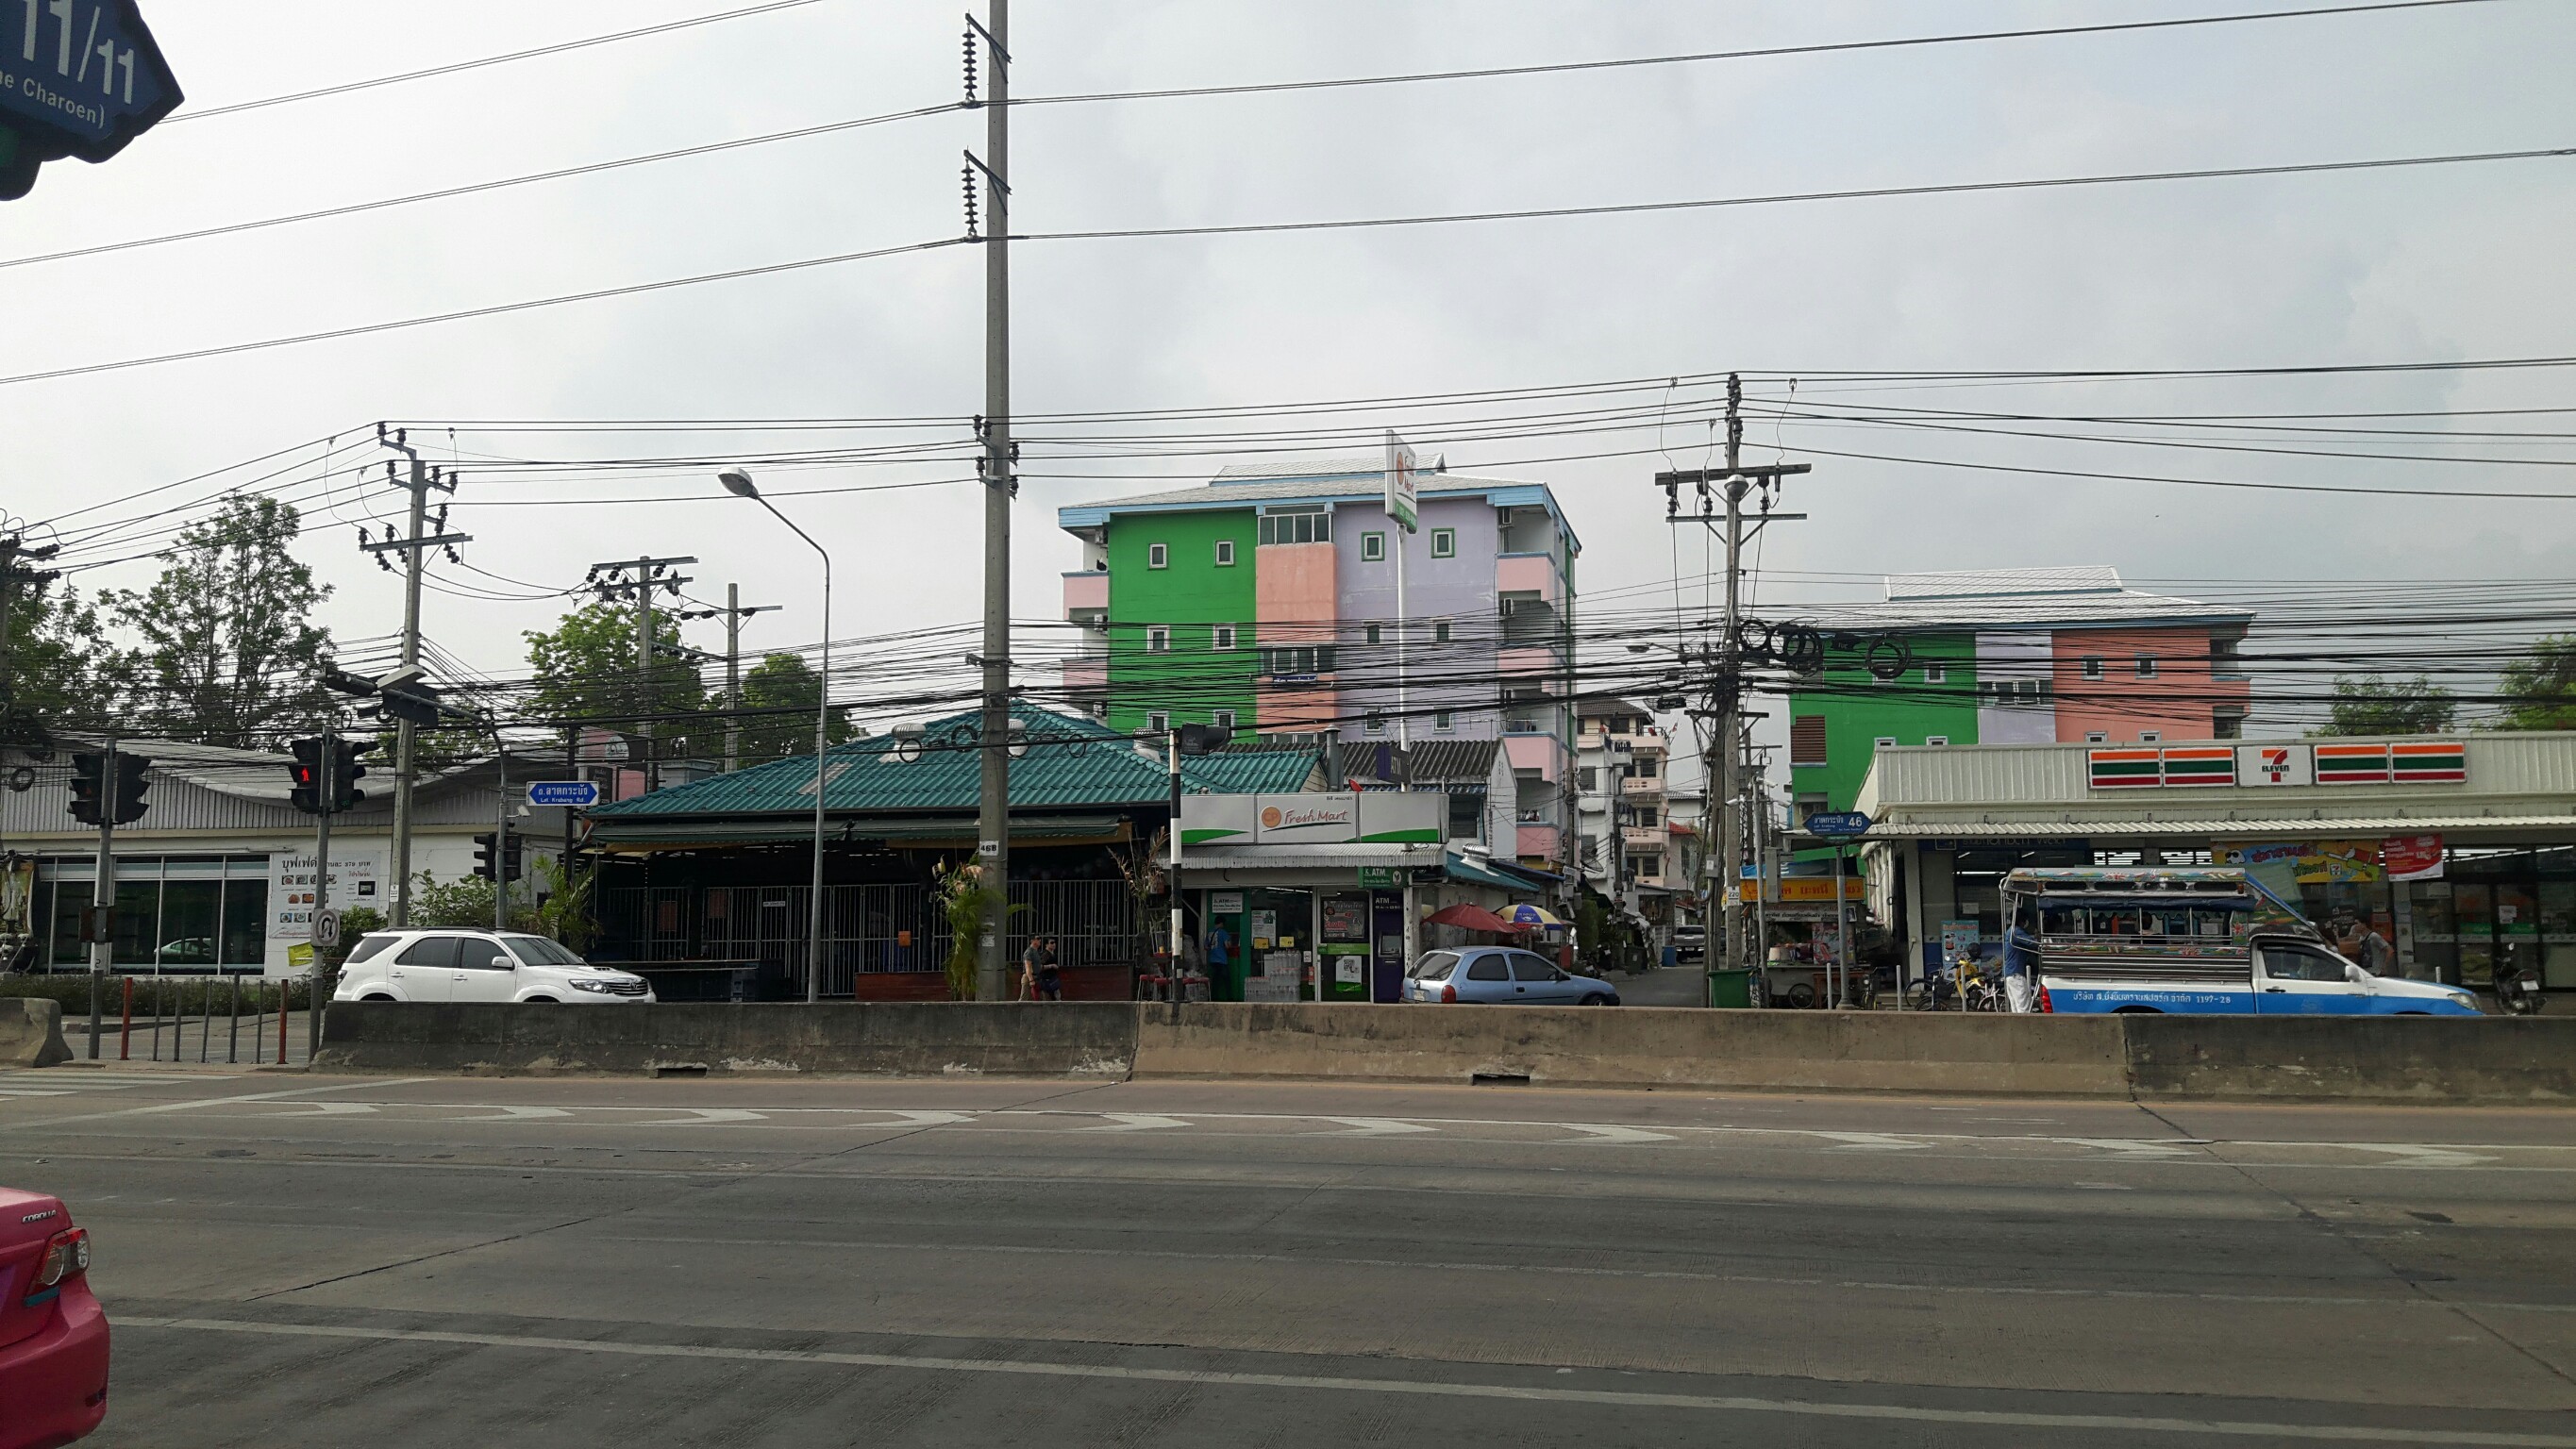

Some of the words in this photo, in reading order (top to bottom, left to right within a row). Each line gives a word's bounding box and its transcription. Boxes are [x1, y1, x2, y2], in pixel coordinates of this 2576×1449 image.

[23, 77, 105, 129] Charoen)
[1284, 808, 1315, 824] Fresh
[1317, 810, 1347, 822] Mart
[1848, 816, 1863, 826] 46
[1372, 868, 1385, 876] ATM
[2196, 995, 2232, 1004] 1197-28
